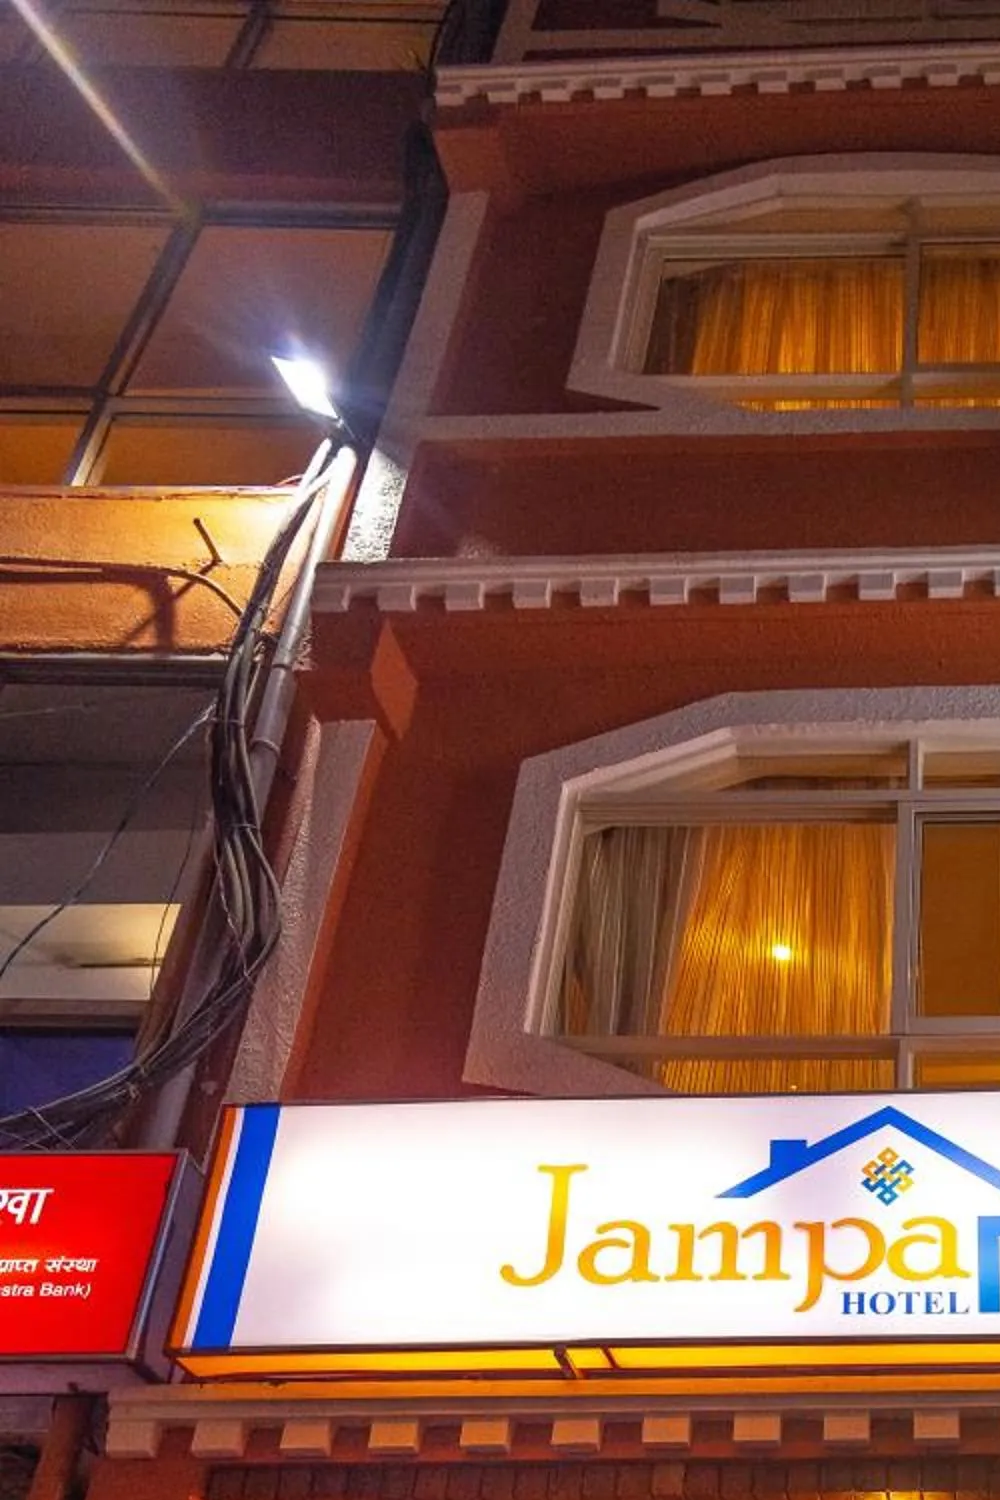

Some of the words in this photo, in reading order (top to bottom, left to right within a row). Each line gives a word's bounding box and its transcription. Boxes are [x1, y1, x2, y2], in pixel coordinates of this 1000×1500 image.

[500, 1163, 971, 1313] Jampa
[45, 1255, 98, 1273] संस्था
[0, 1284, 34, 1297] stra
[39, 1282, 92, 1299] Bank)
[841, 1290, 970, 1315] HOTEL
